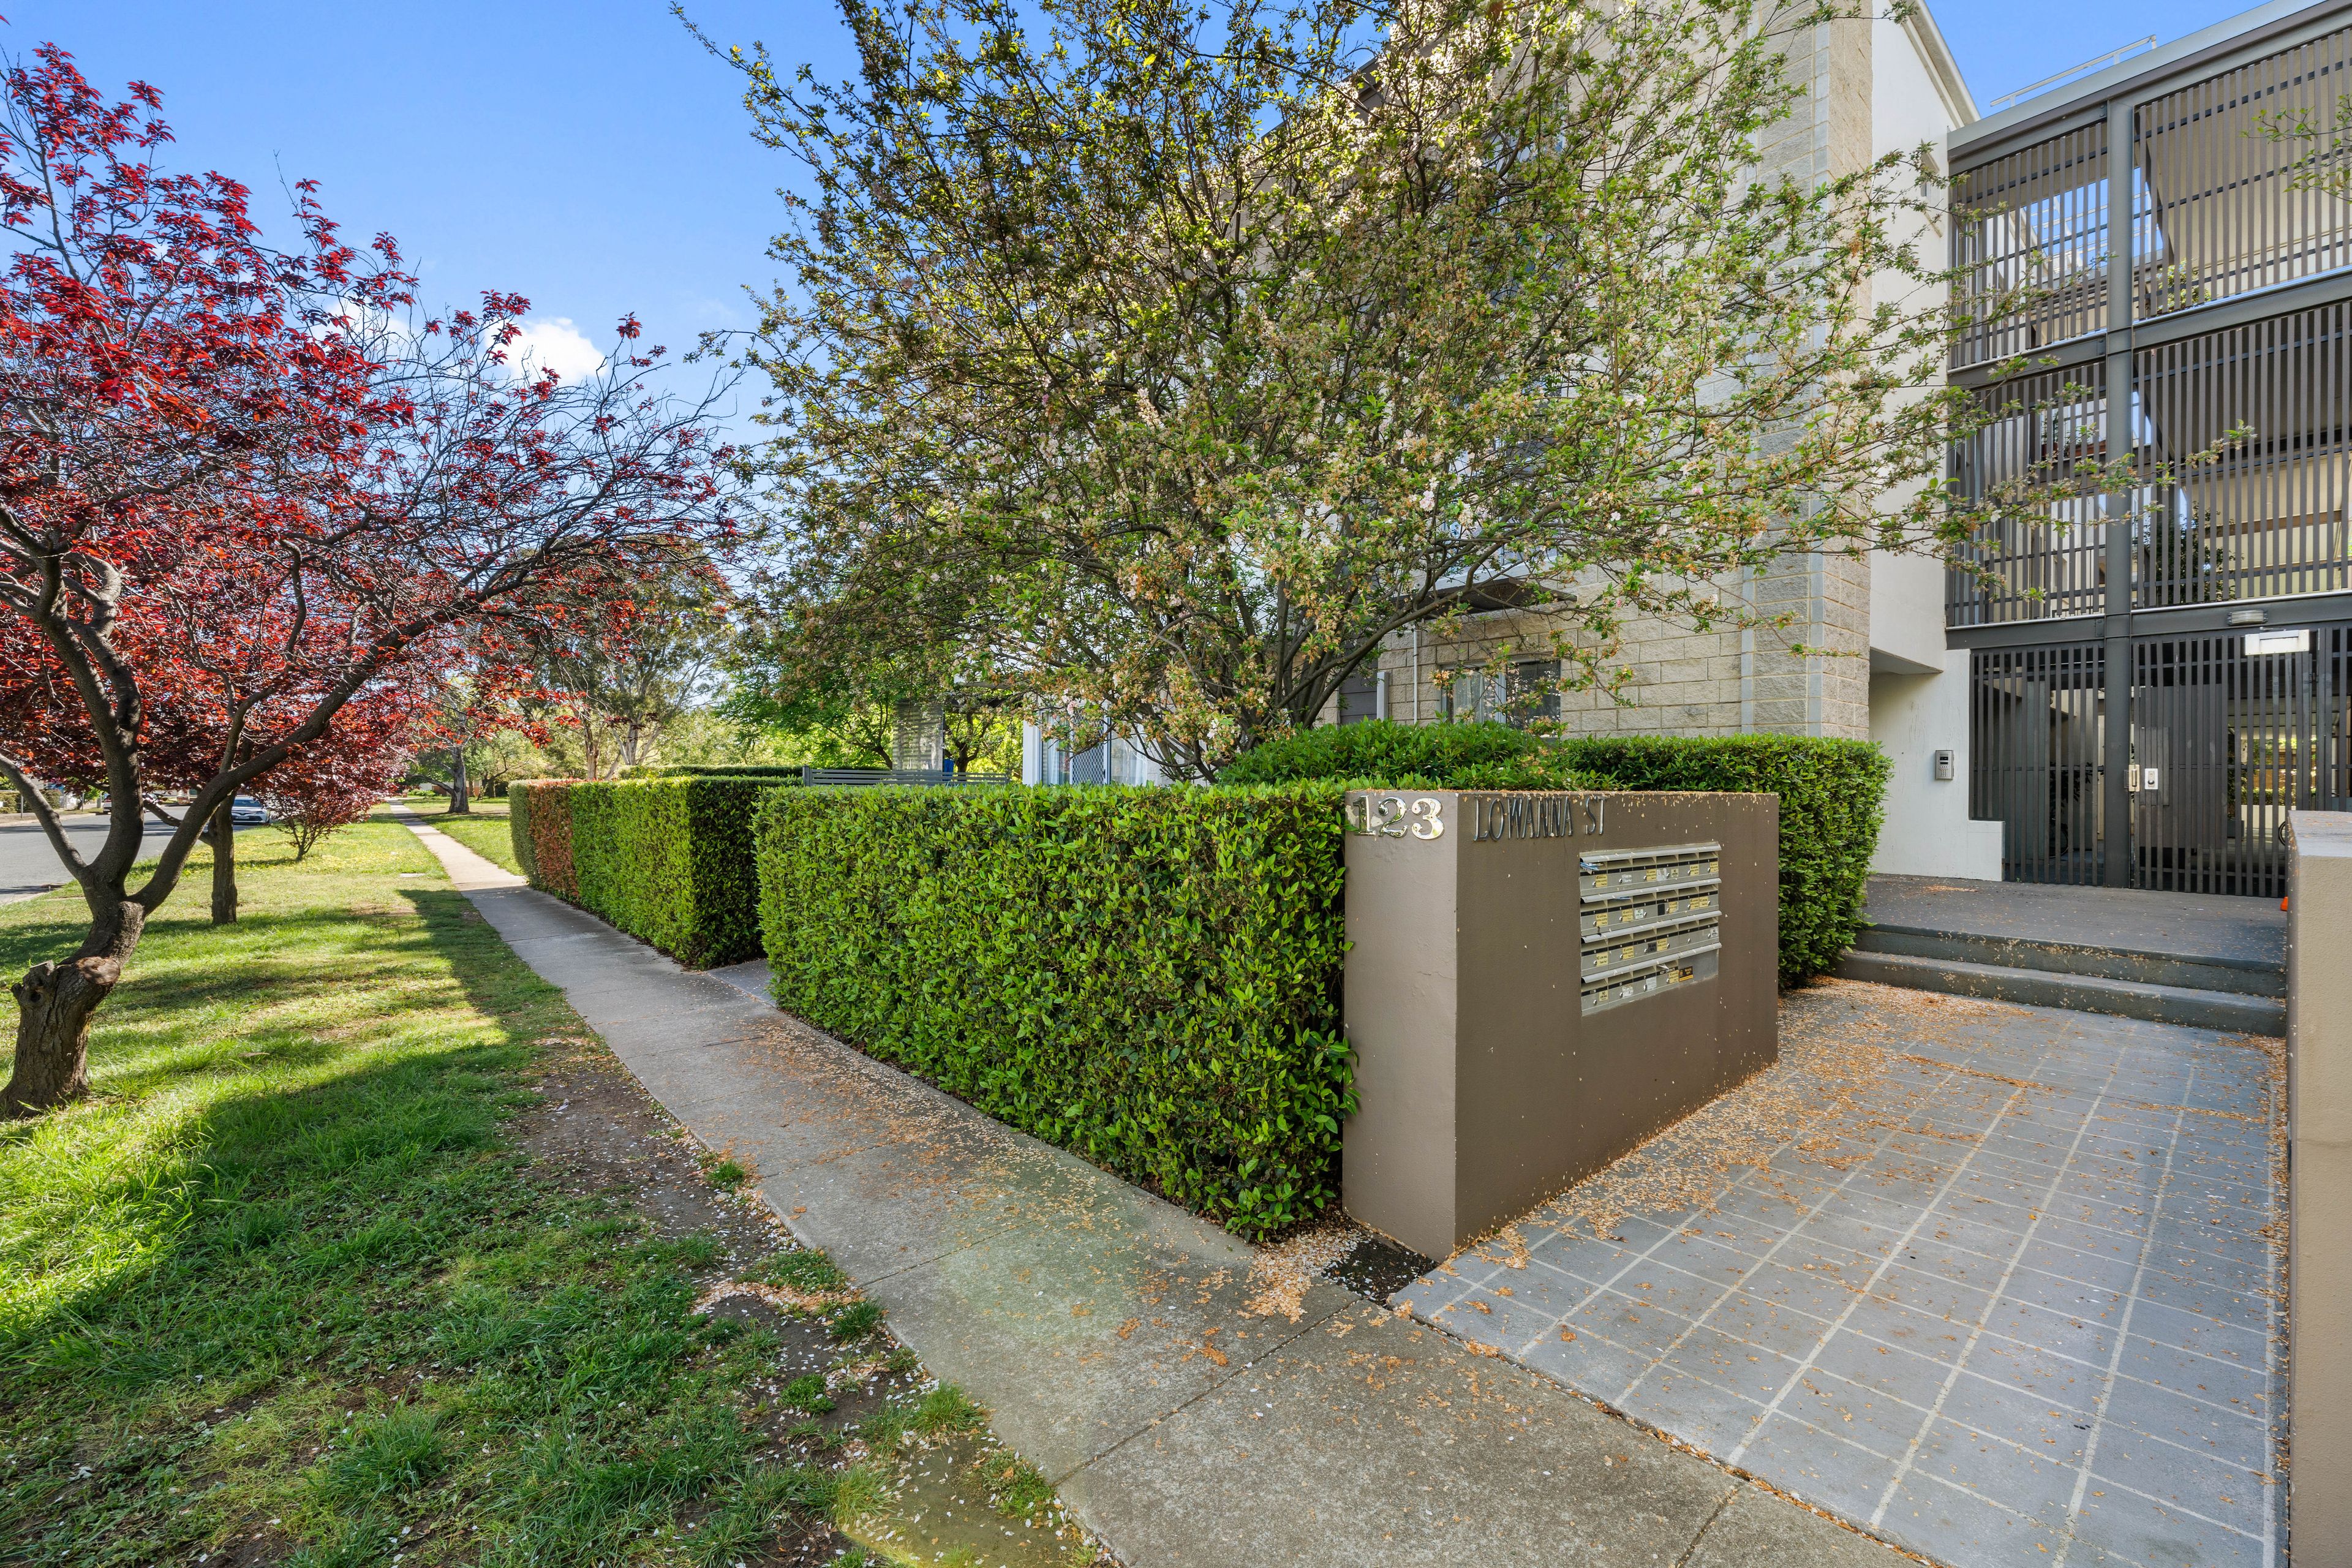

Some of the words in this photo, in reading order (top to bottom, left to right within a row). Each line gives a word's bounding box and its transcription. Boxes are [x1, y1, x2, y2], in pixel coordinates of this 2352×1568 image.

[1352, 795, 1444, 840] 123
[1473, 796, 1573, 841] LOWANNA
[1585, 795, 1607, 835] ST
